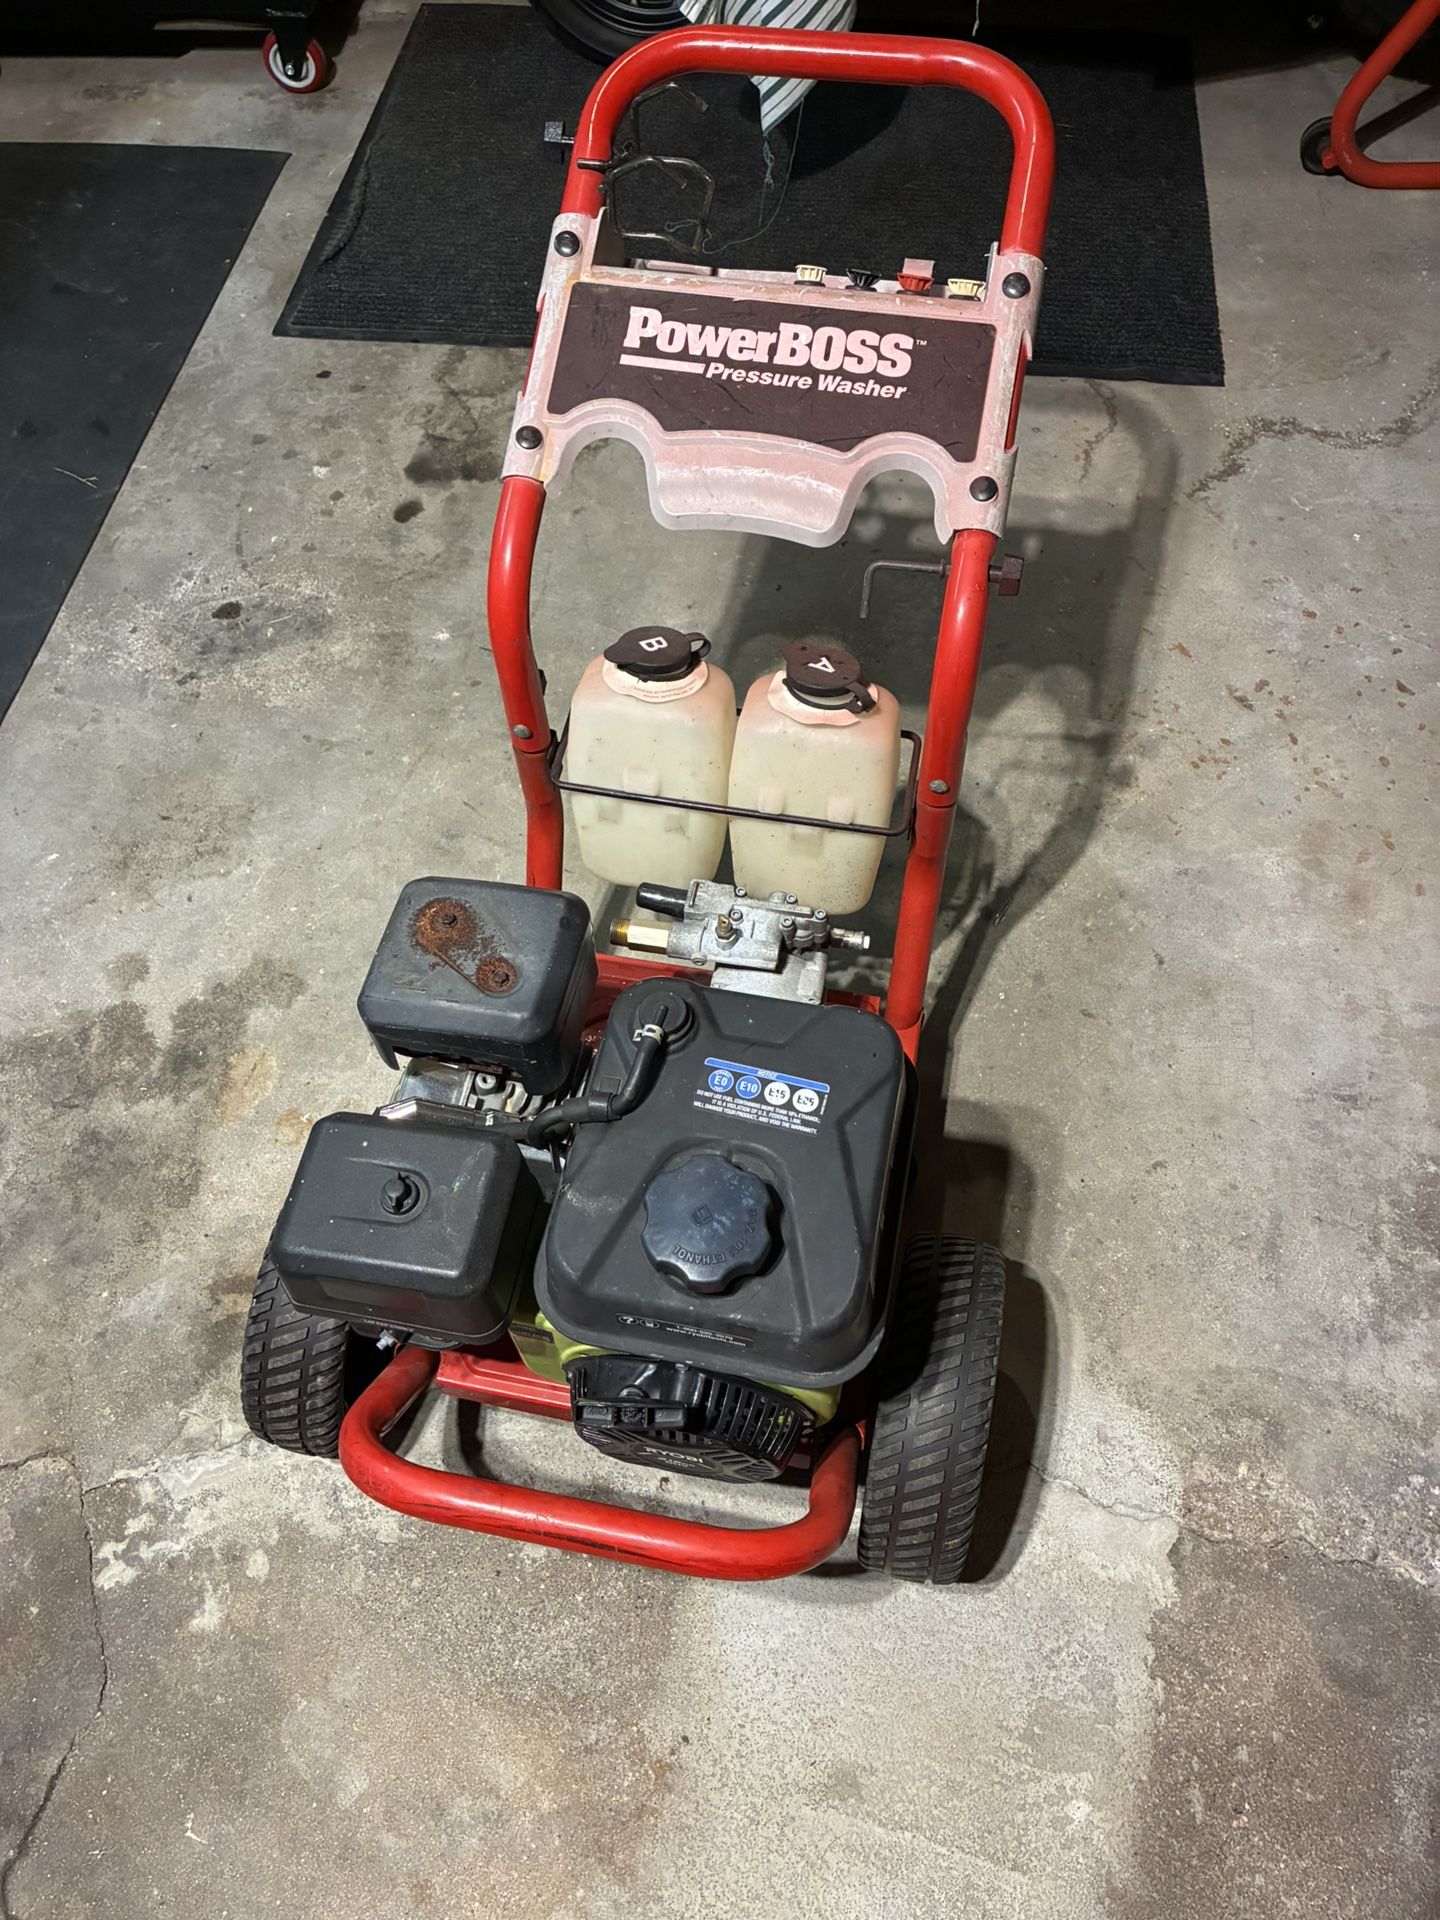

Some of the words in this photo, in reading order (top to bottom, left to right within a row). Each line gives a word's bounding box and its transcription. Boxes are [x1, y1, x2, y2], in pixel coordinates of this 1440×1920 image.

[705, 362, 813, 390] Pressure
[817, 375, 907, 400] Washer
[639, 636, 668, 652] B
[809, 656, 836, 673] A
[714, 1075, 728, 1086] E0
[739, 1081, 758, 1093] E10
[726, 1102, 751, 1113] VIOLATION
[768, 1112, 790, 1122] FEDERAL
[672, 1243, 726, 1266] ETHANOL
[644, 1446, 703, 1463] RYOBI
